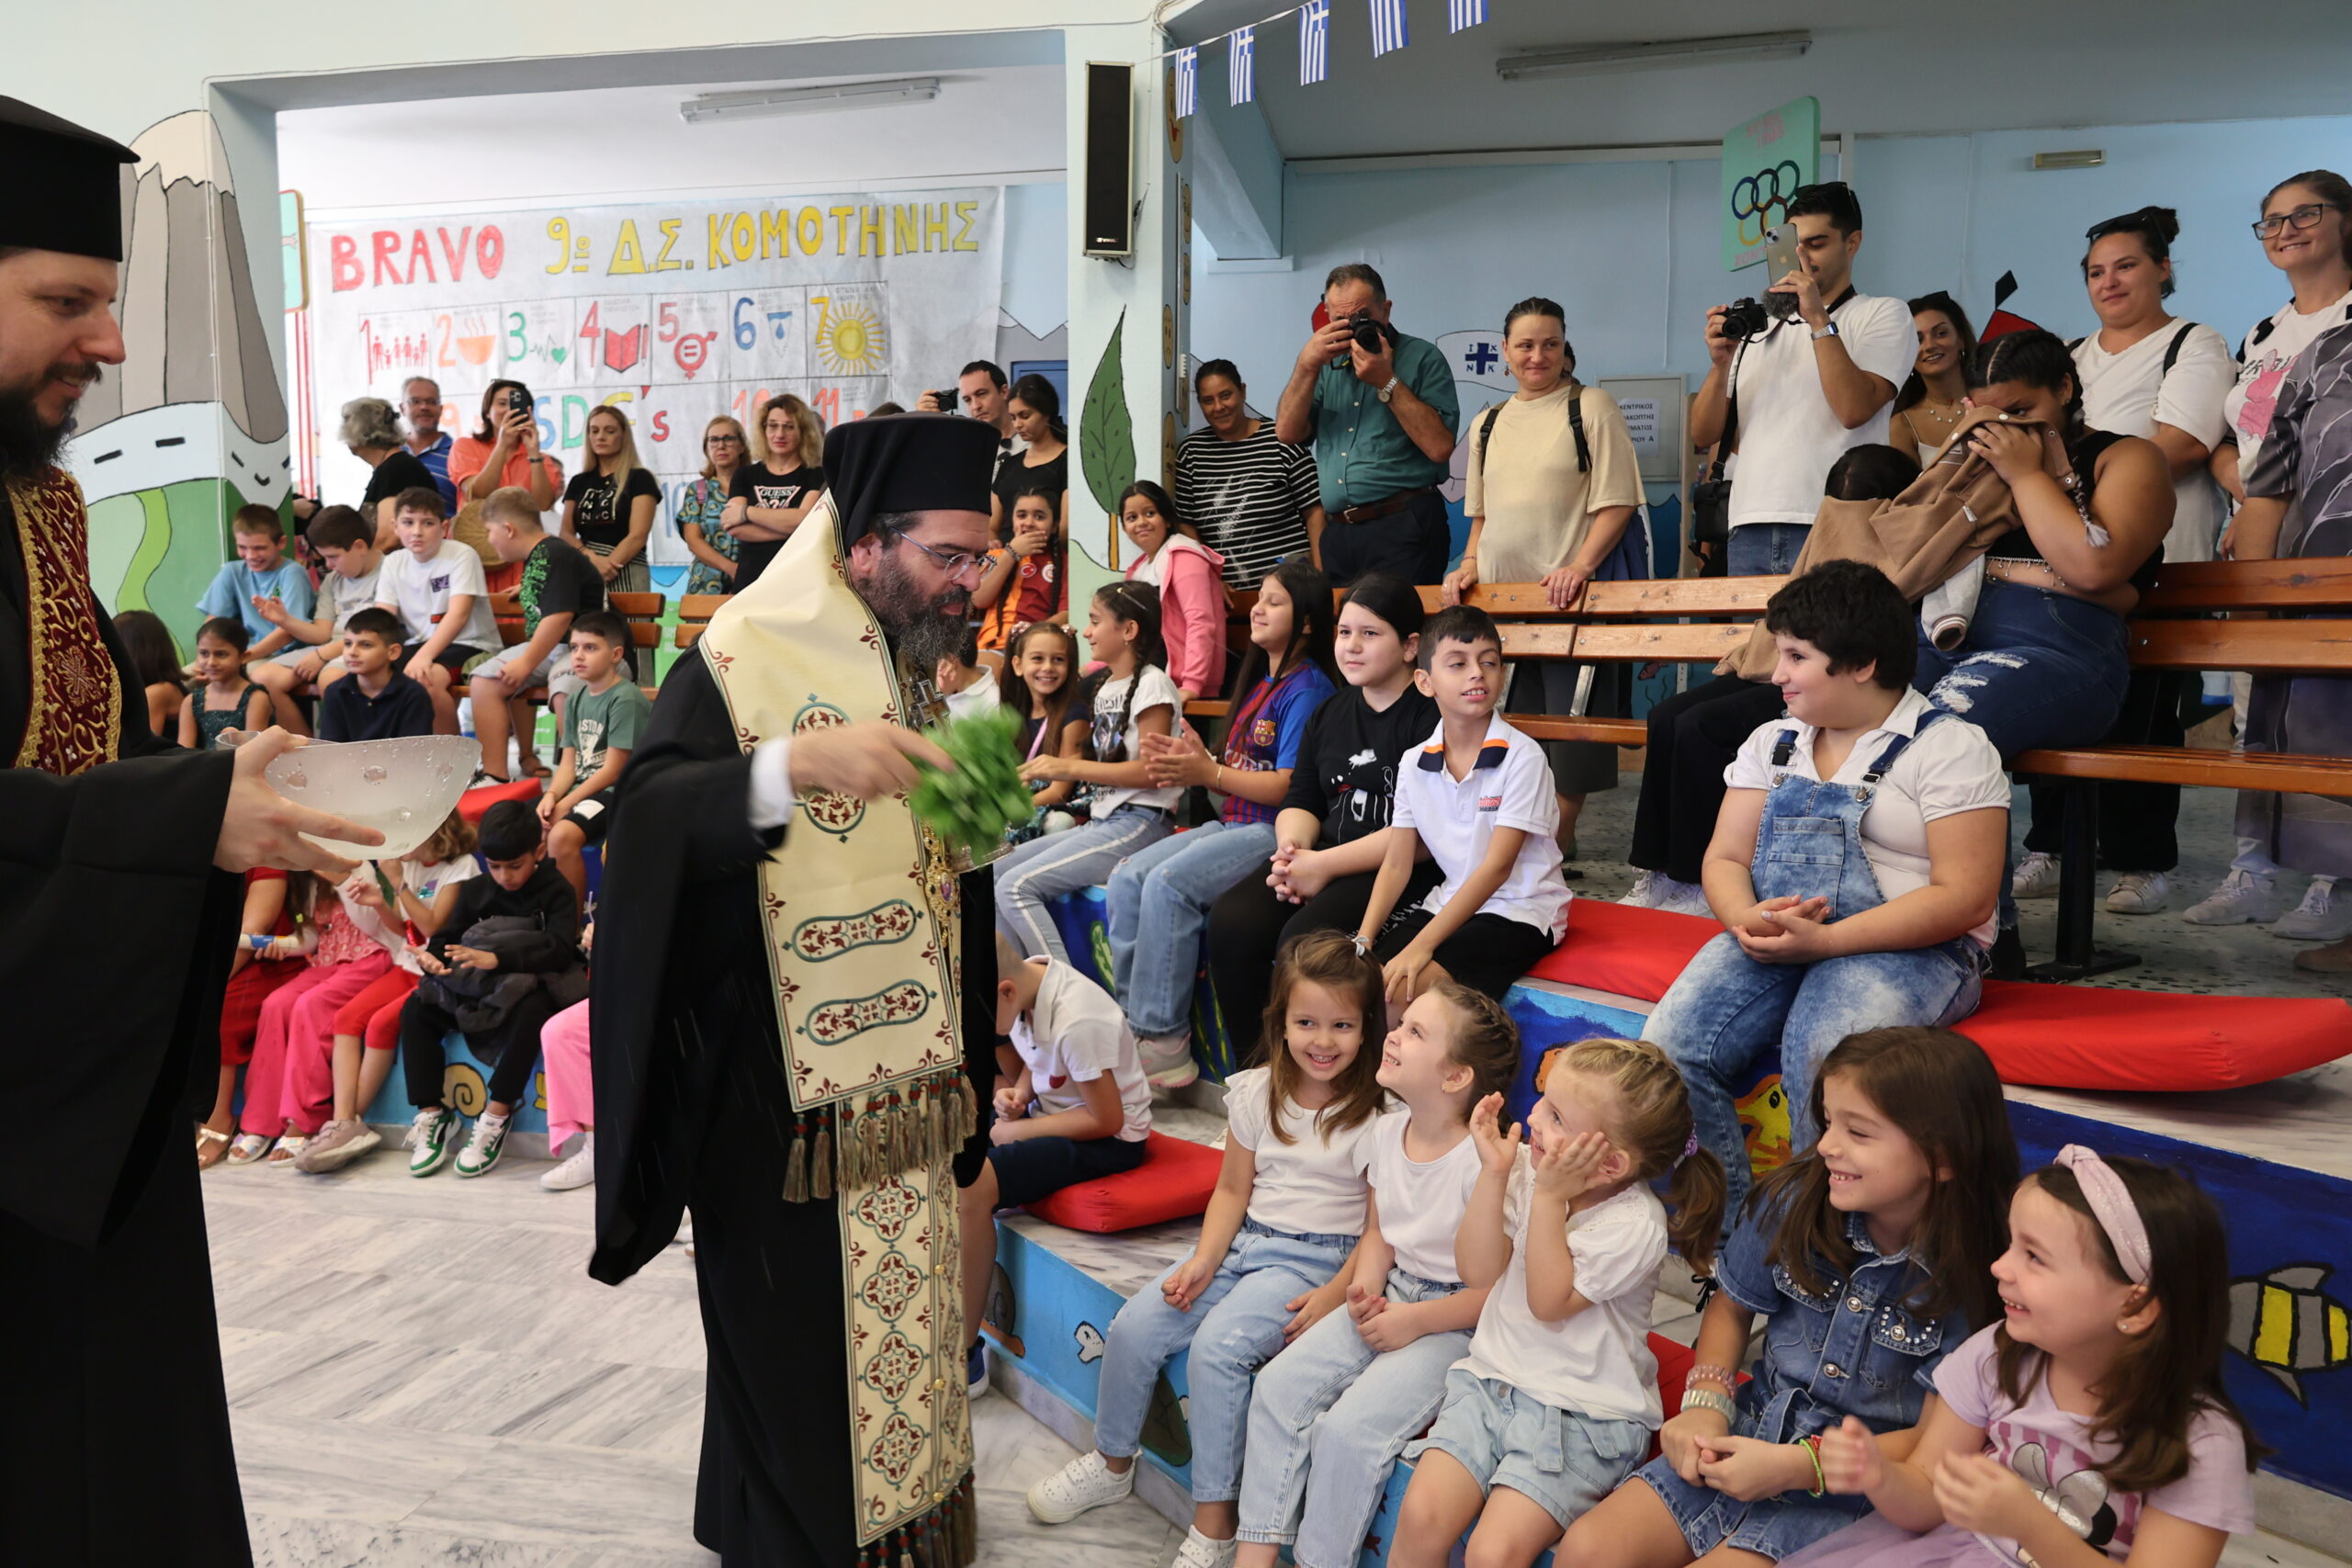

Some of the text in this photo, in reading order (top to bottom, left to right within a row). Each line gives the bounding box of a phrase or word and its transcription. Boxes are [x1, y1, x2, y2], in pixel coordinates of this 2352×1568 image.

[332, 224, 504, 293] BRAVO
[606, 218, 695, 276] Δ.Σ.
[707, 201, 979, 271] ΚΟΜΟΤΗΝΗΣ
[436, 314, 457, 367] 2
[508, 311, 528, 362] 3
[579, 301, 602, 368] 4
[658, 302, 680, 343] 5
[734, 297, 757, 351] 6
[810, 296, 831, 344] 7
[359, 319, 372, 386] 1
[760, 489, 792, 497] GUESS
